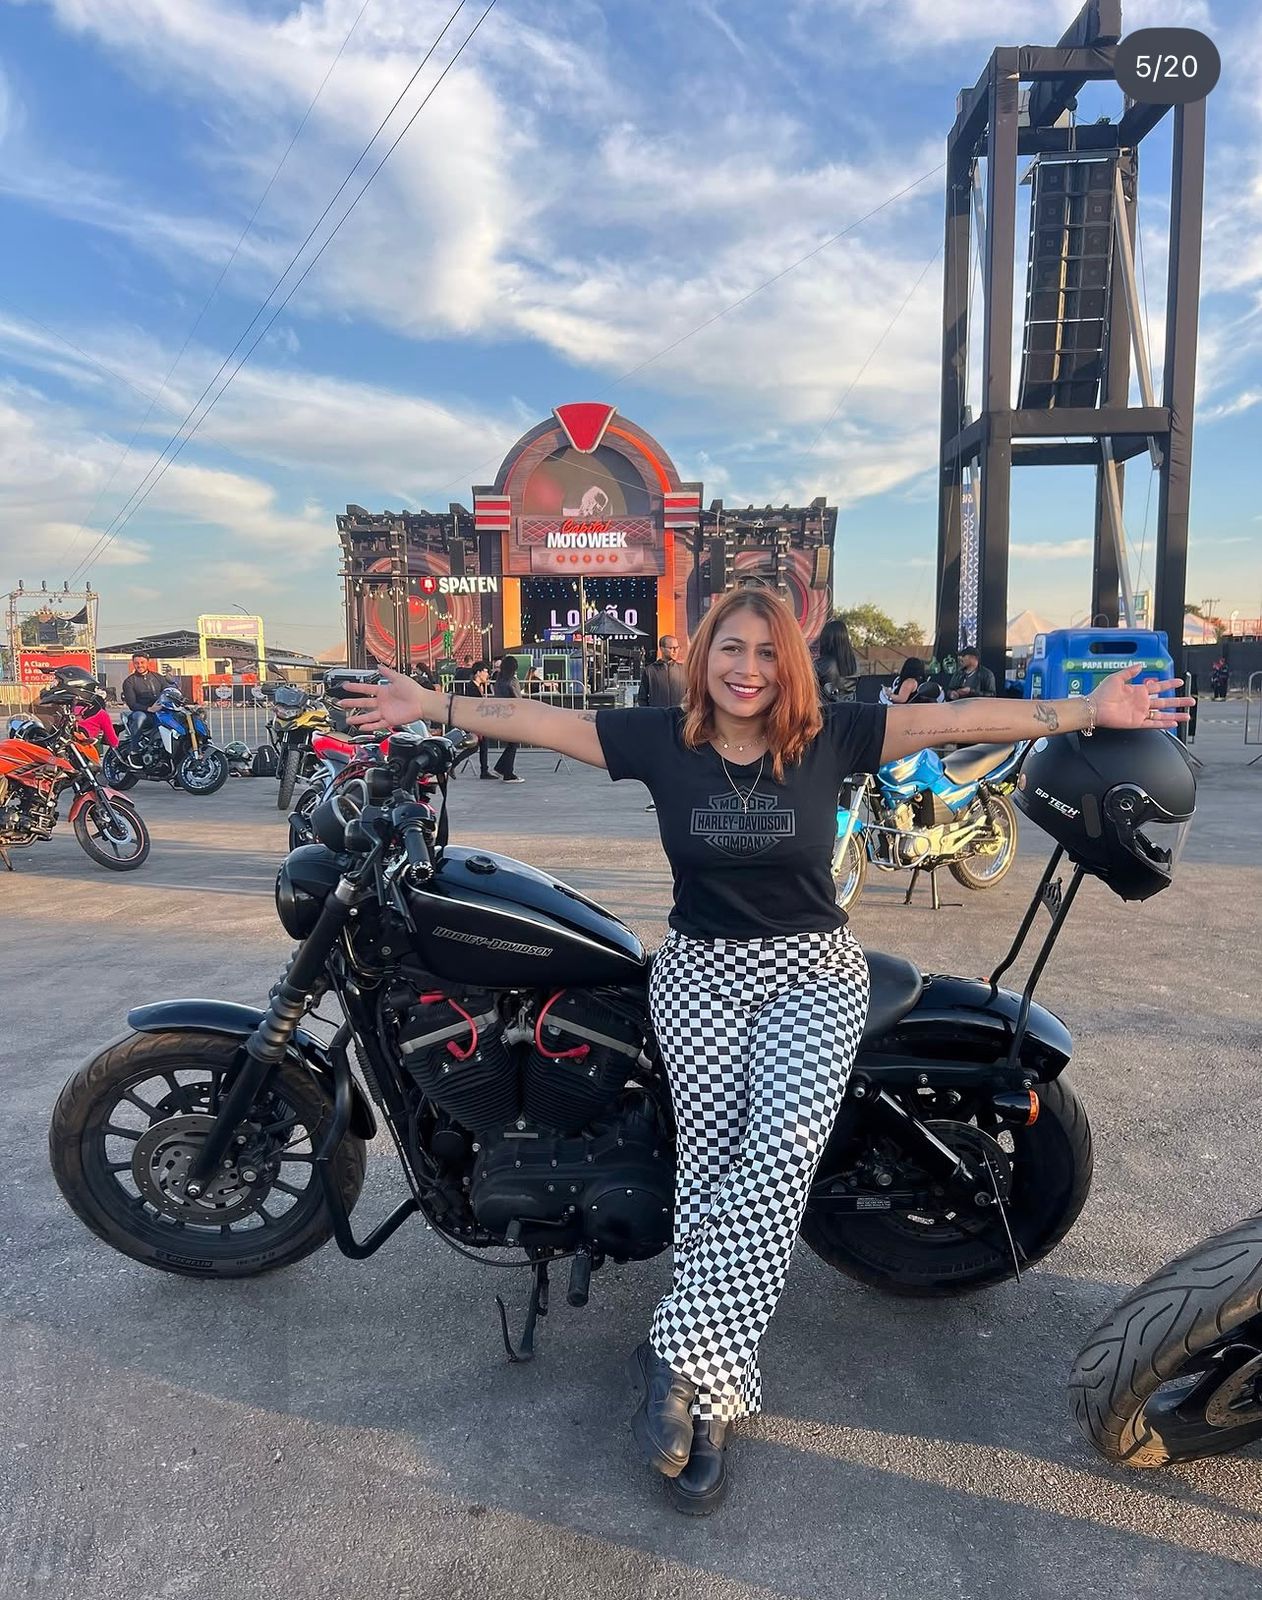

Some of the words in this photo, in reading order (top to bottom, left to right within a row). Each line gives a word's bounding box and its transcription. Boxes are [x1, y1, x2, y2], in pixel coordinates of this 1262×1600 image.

[562, 518, 612, 533] Capital
[438, 576, 498, 593] SPATEN
[1082, 661, 1102, 669] PAPA
[1034, 787, 1050, 800] GP
[1049, 797, 1080, 816] TECH
[697, 815, 789, 831] HARLEY-DAVIDSON
[717, 835, 768, 851] COMPANY
[432, 926, 554, 957] HARLEY-DAVIDSON
